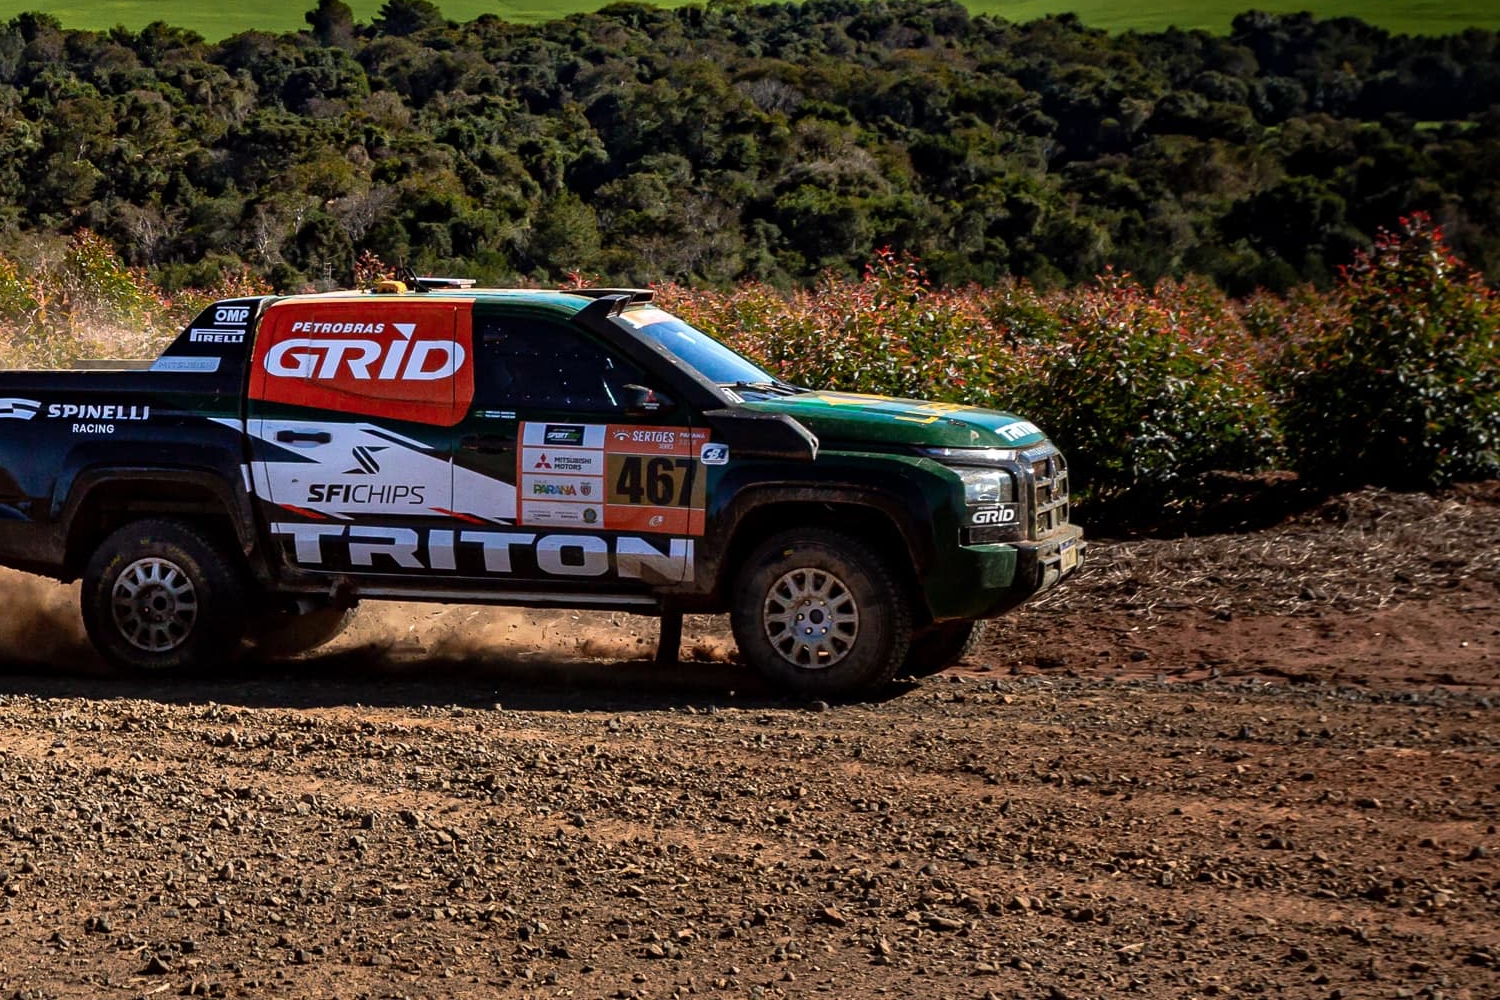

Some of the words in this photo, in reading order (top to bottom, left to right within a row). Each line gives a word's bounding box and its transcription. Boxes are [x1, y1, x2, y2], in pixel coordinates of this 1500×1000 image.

[215, 309, 249, 321] OMP
[190, 328, 245, 343] PIRELLI
[292, 322, 385, 334] PETROBRAS
[264, 324, 466, 381] GRID
[47, 404, 150, 420] SPINELLI
[72, 424, 115, 434] RACING
[554, 457, 592, 465] MITSUBISHI
[702, 447, 727, 460] CBA
[616, 456, 698, 507] 467
[307, 484, 426, 505] SFICHIPS
[972, 505, 1015, 524] GRID
[270, 522, 696, 582] TRITON
